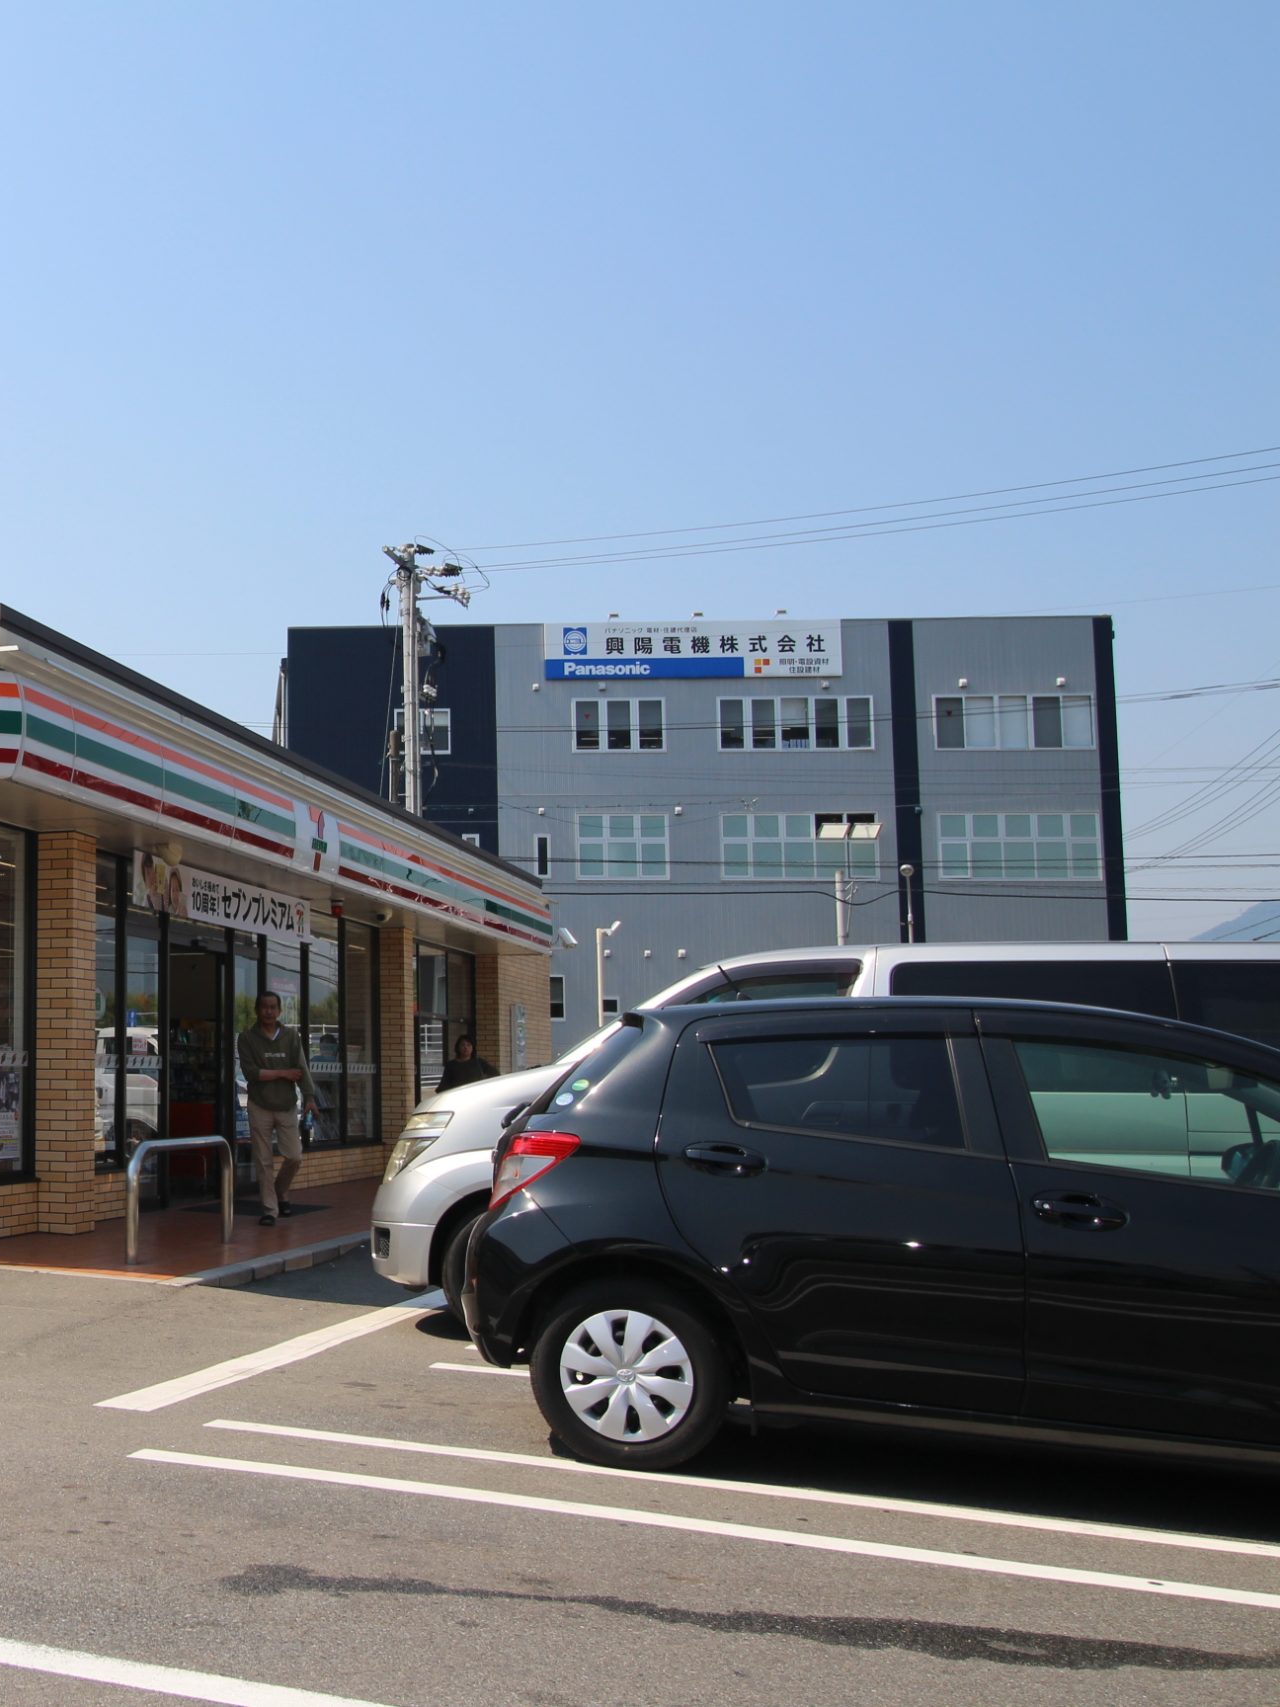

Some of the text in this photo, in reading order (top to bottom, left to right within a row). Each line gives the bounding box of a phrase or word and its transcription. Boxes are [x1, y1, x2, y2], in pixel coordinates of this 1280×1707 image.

[606, 634, 826, 655] 興陽電機株式会社
[564, 661, 650, 676] Panasonic
[221, 886, 295, 931] セブンプレミアム
